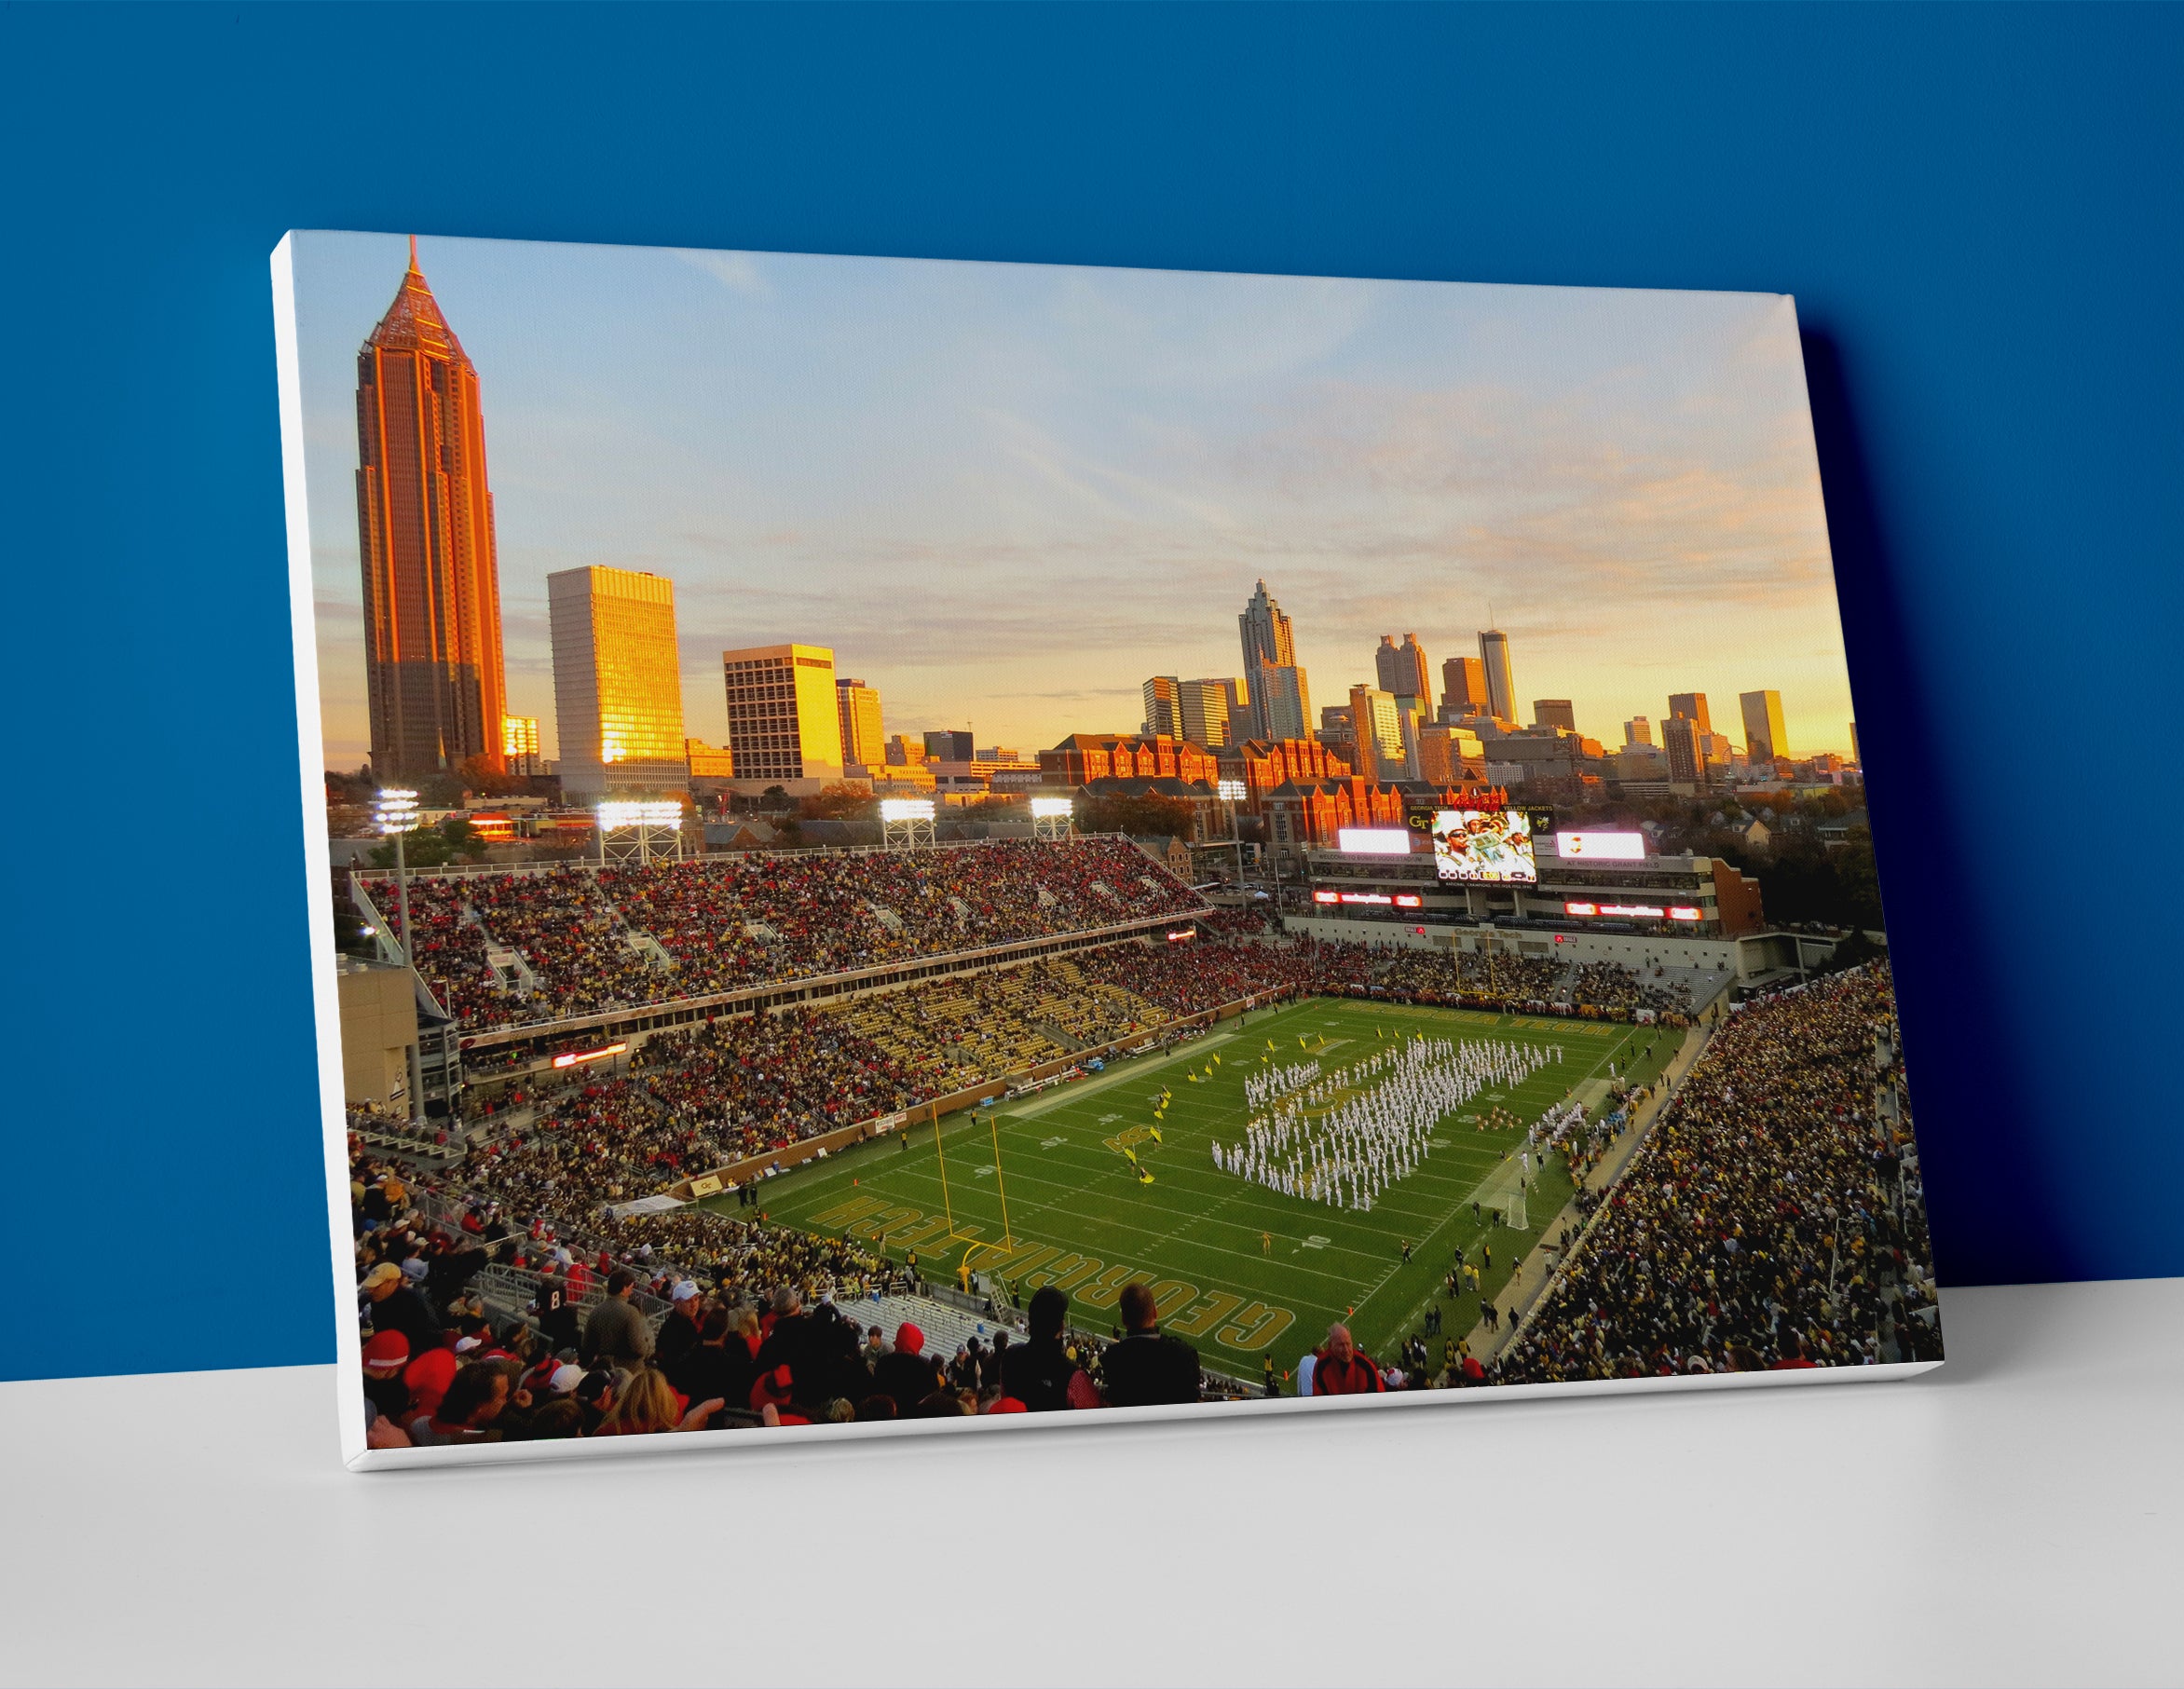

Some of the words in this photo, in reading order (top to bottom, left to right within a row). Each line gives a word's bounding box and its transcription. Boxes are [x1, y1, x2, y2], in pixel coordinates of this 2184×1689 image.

[1409, 815, 1428, 829] GT
[1496, 930, 1522, 939] Tech
[1509, 1015, 1617, 1037] TECH
[805, 1195, 986, 1260] TECH
[551, 1290, 560, 1309] 8
[962, 1234, 1297, 1352] GEORGIA
